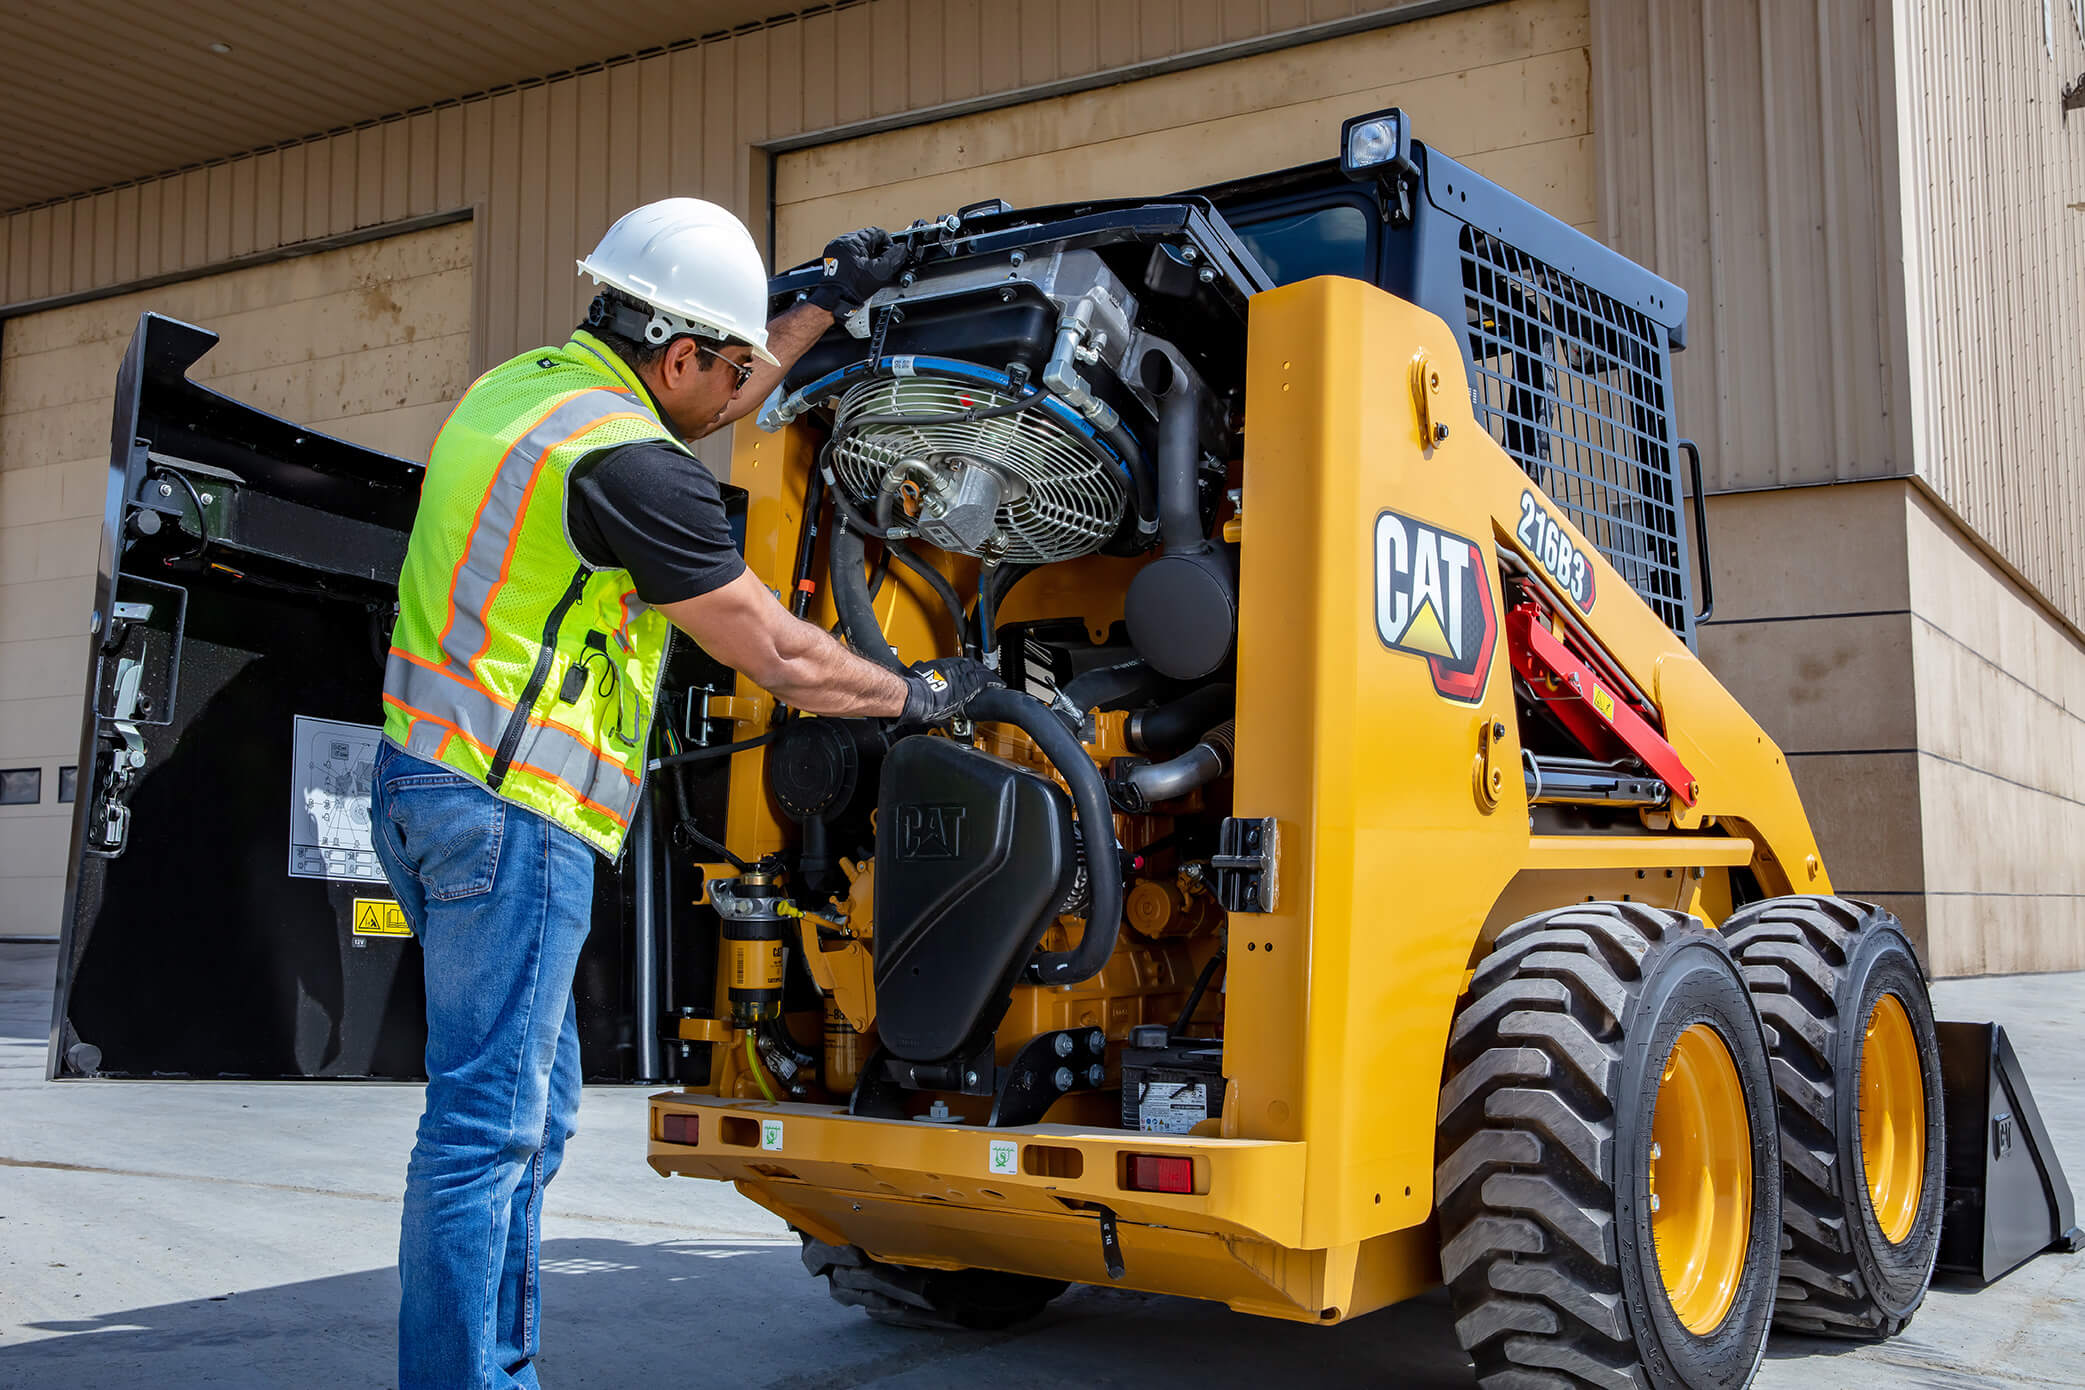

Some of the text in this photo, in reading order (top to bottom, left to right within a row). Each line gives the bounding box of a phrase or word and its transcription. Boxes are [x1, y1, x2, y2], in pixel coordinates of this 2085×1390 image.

[824, 256, 839, 276] CA
[1518, 492, 1585, 601] 216B3
[1376, 514, 1469, 660] CAT
[915, 668, 949, 692] CAT
[896, 806, 967, 859] CAT
